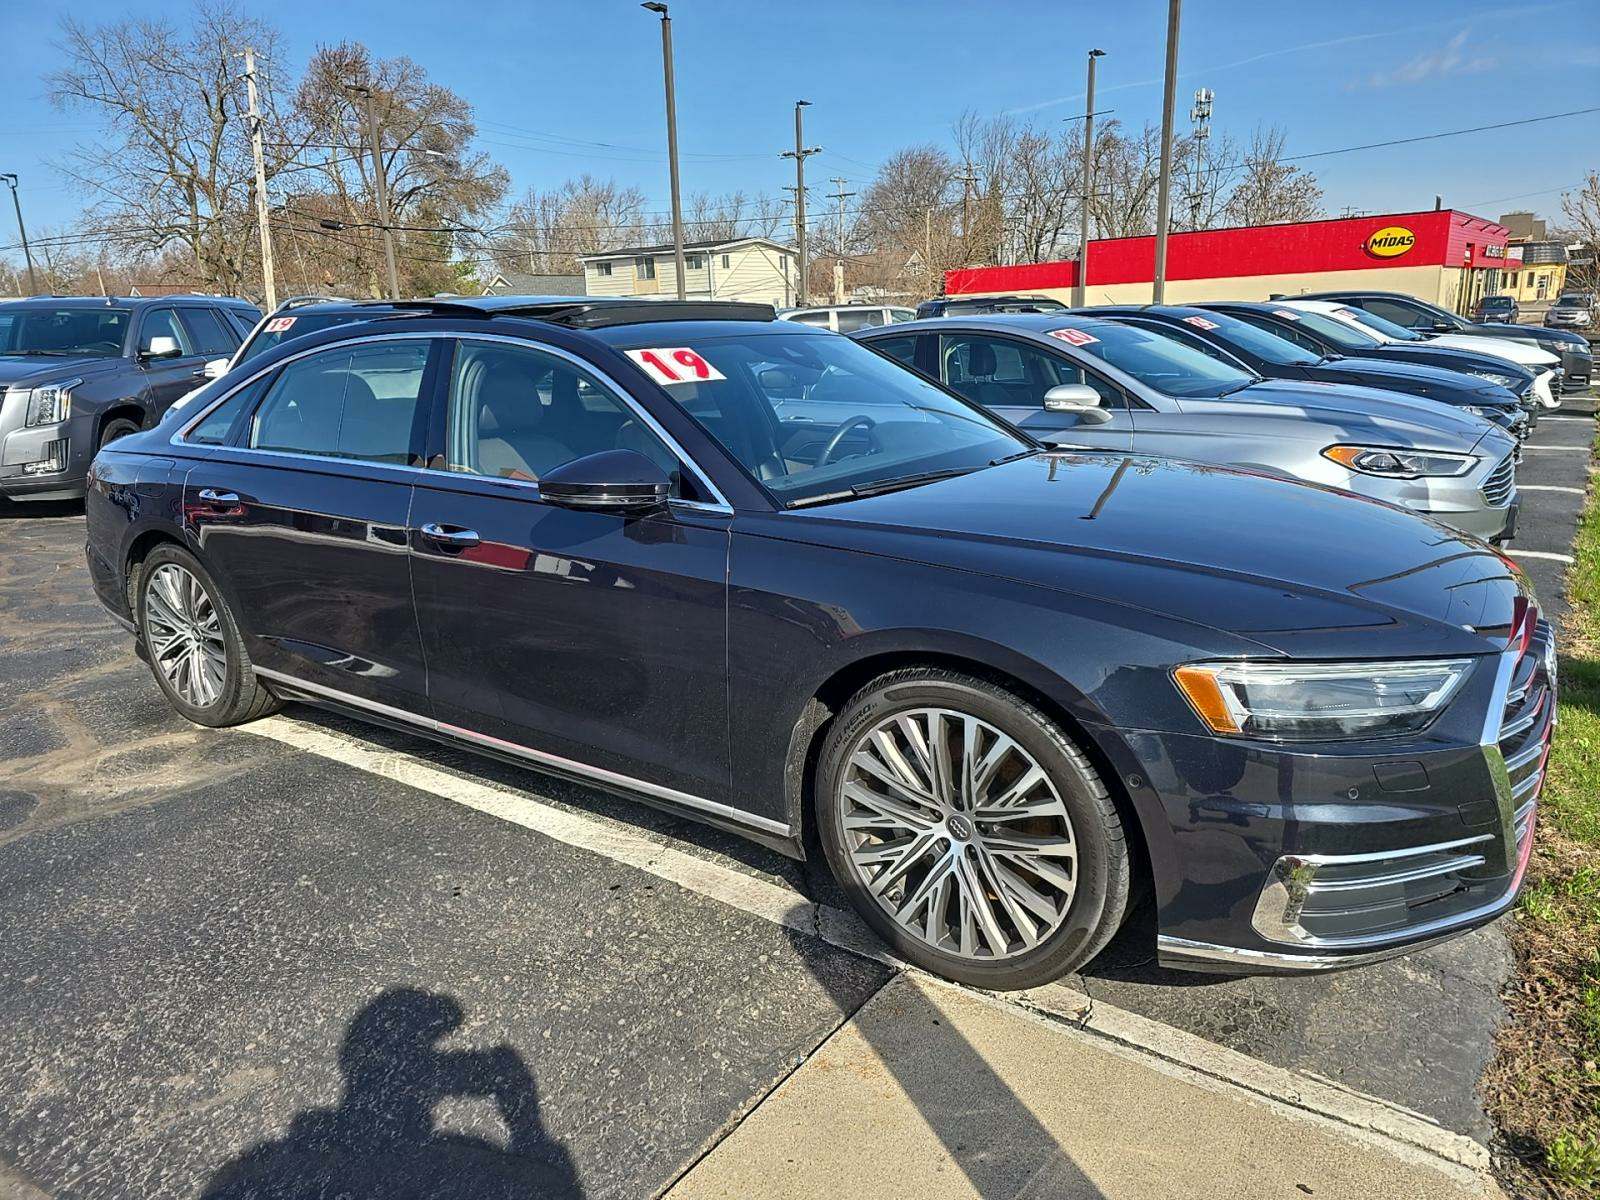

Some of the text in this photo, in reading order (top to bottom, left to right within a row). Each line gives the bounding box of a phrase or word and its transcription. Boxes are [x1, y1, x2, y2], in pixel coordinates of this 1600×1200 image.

[1370, 233, 1415, 249] MIDAS
[270, 318, 293, 330] 19
[1054, 330, 1092, 344] 20
[640, 351, 709, 381] 19
